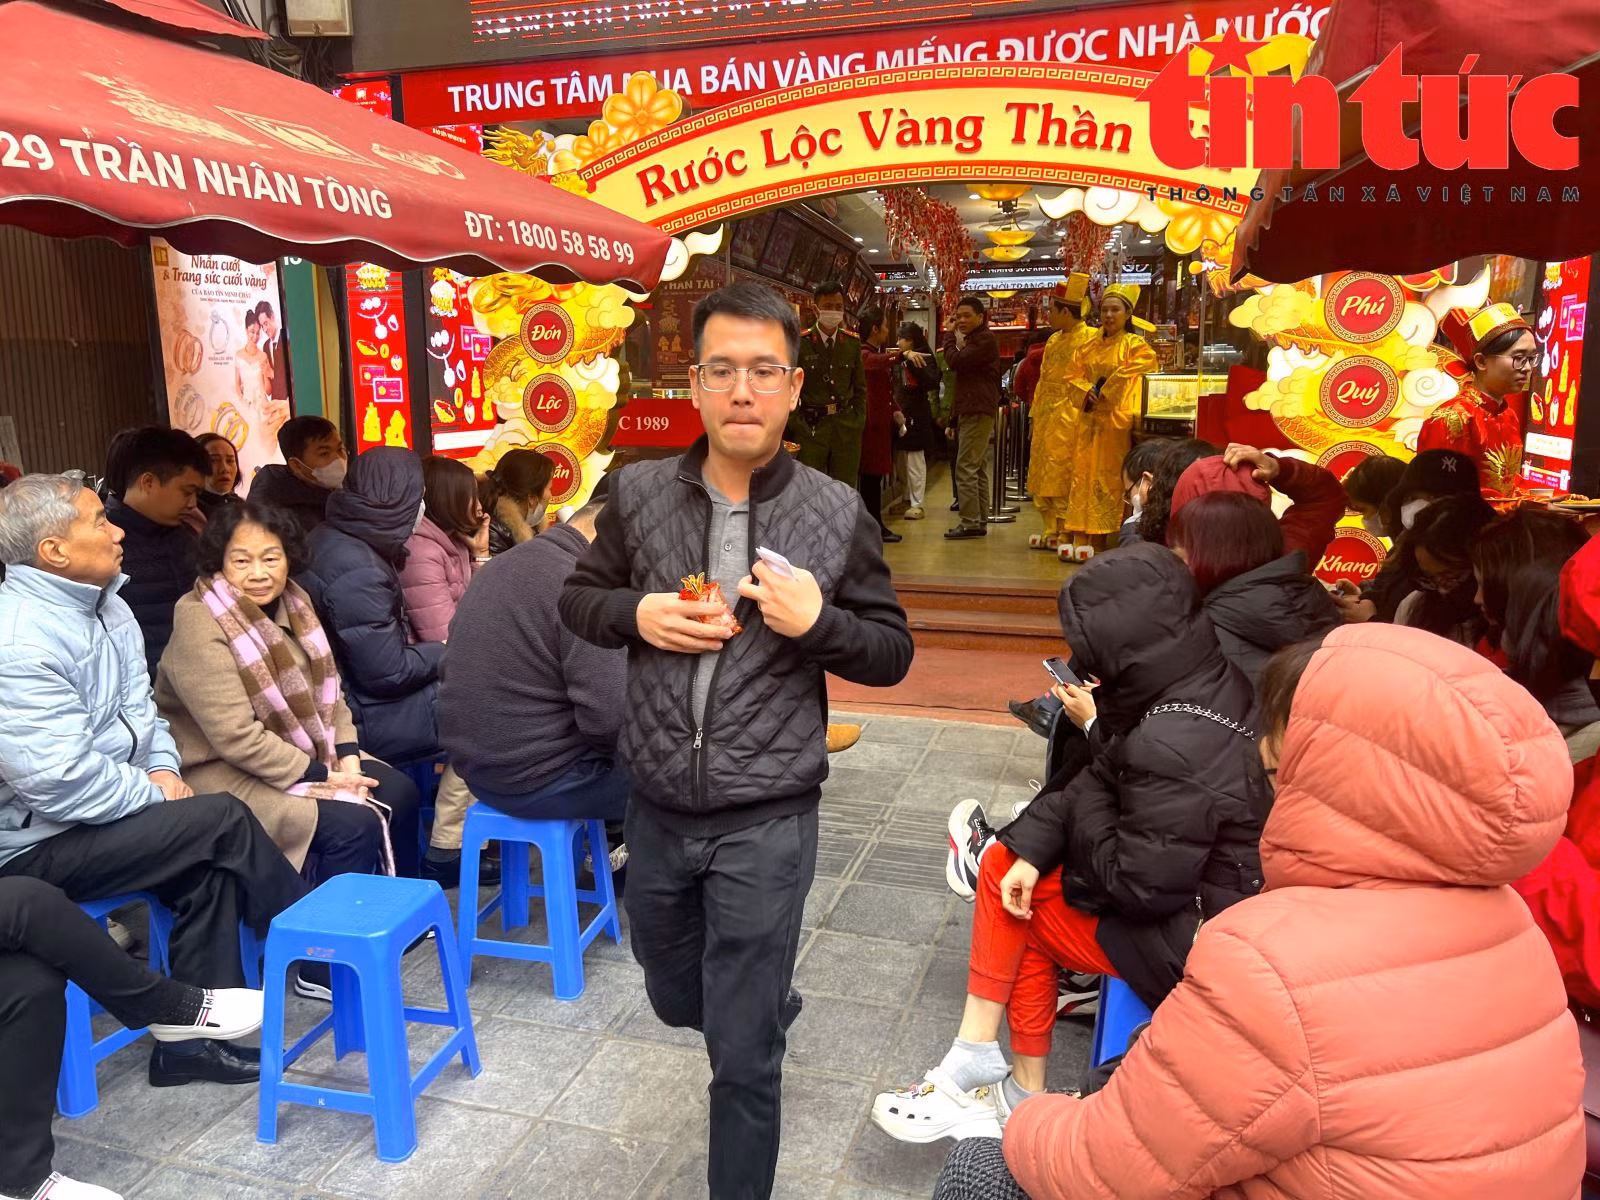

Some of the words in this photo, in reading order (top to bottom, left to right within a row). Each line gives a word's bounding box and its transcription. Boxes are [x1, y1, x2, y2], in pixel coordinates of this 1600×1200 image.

[448, 79, 545, 112] TRUNG
[550, 70, 613, 105] TÂM
[701, 57, 767, 94] BÁN
[773, 51, 866, 88] VÀNG
[876, 35, 989, 70] MIẾNG
[1119, 14, 1201, 59] NHÀ
[638, 150, 748, 207] Rước
[762, 122, 842, 170] Lộc
[858, 106, 984, 153] Vàng
[1004, 99, 1133, 154] Thần
[0, 131, 54, 171] 29
[60, 136, 187, 190] TRẦN
[193, 158, 302, 206] NHÂN
[303, 175, 393, 219] TÔNG
[464, 210, 504, 242] ĐT:
[507, 220, 557, 251] 1800
[560, 229, 585, 256] 58
[588, 234, 611, 261] 58
[613, 240, 634, 265] 99
[172, 267, 202, 287] Trang
[204, 270, 221, 285] sức
[222, 272, 243, 286] cưới
[245, 274, 267, 291] vàng
[1341, 294, 1385, 318] Phú
[532, 323, 562, 341] Đón
[536, 394, 563, 413] Lộc
[1337, 380, 1381, 405] Quý
[635, 415, 669, 431] 1989
[1315, 555, 1379, 579] Khang
